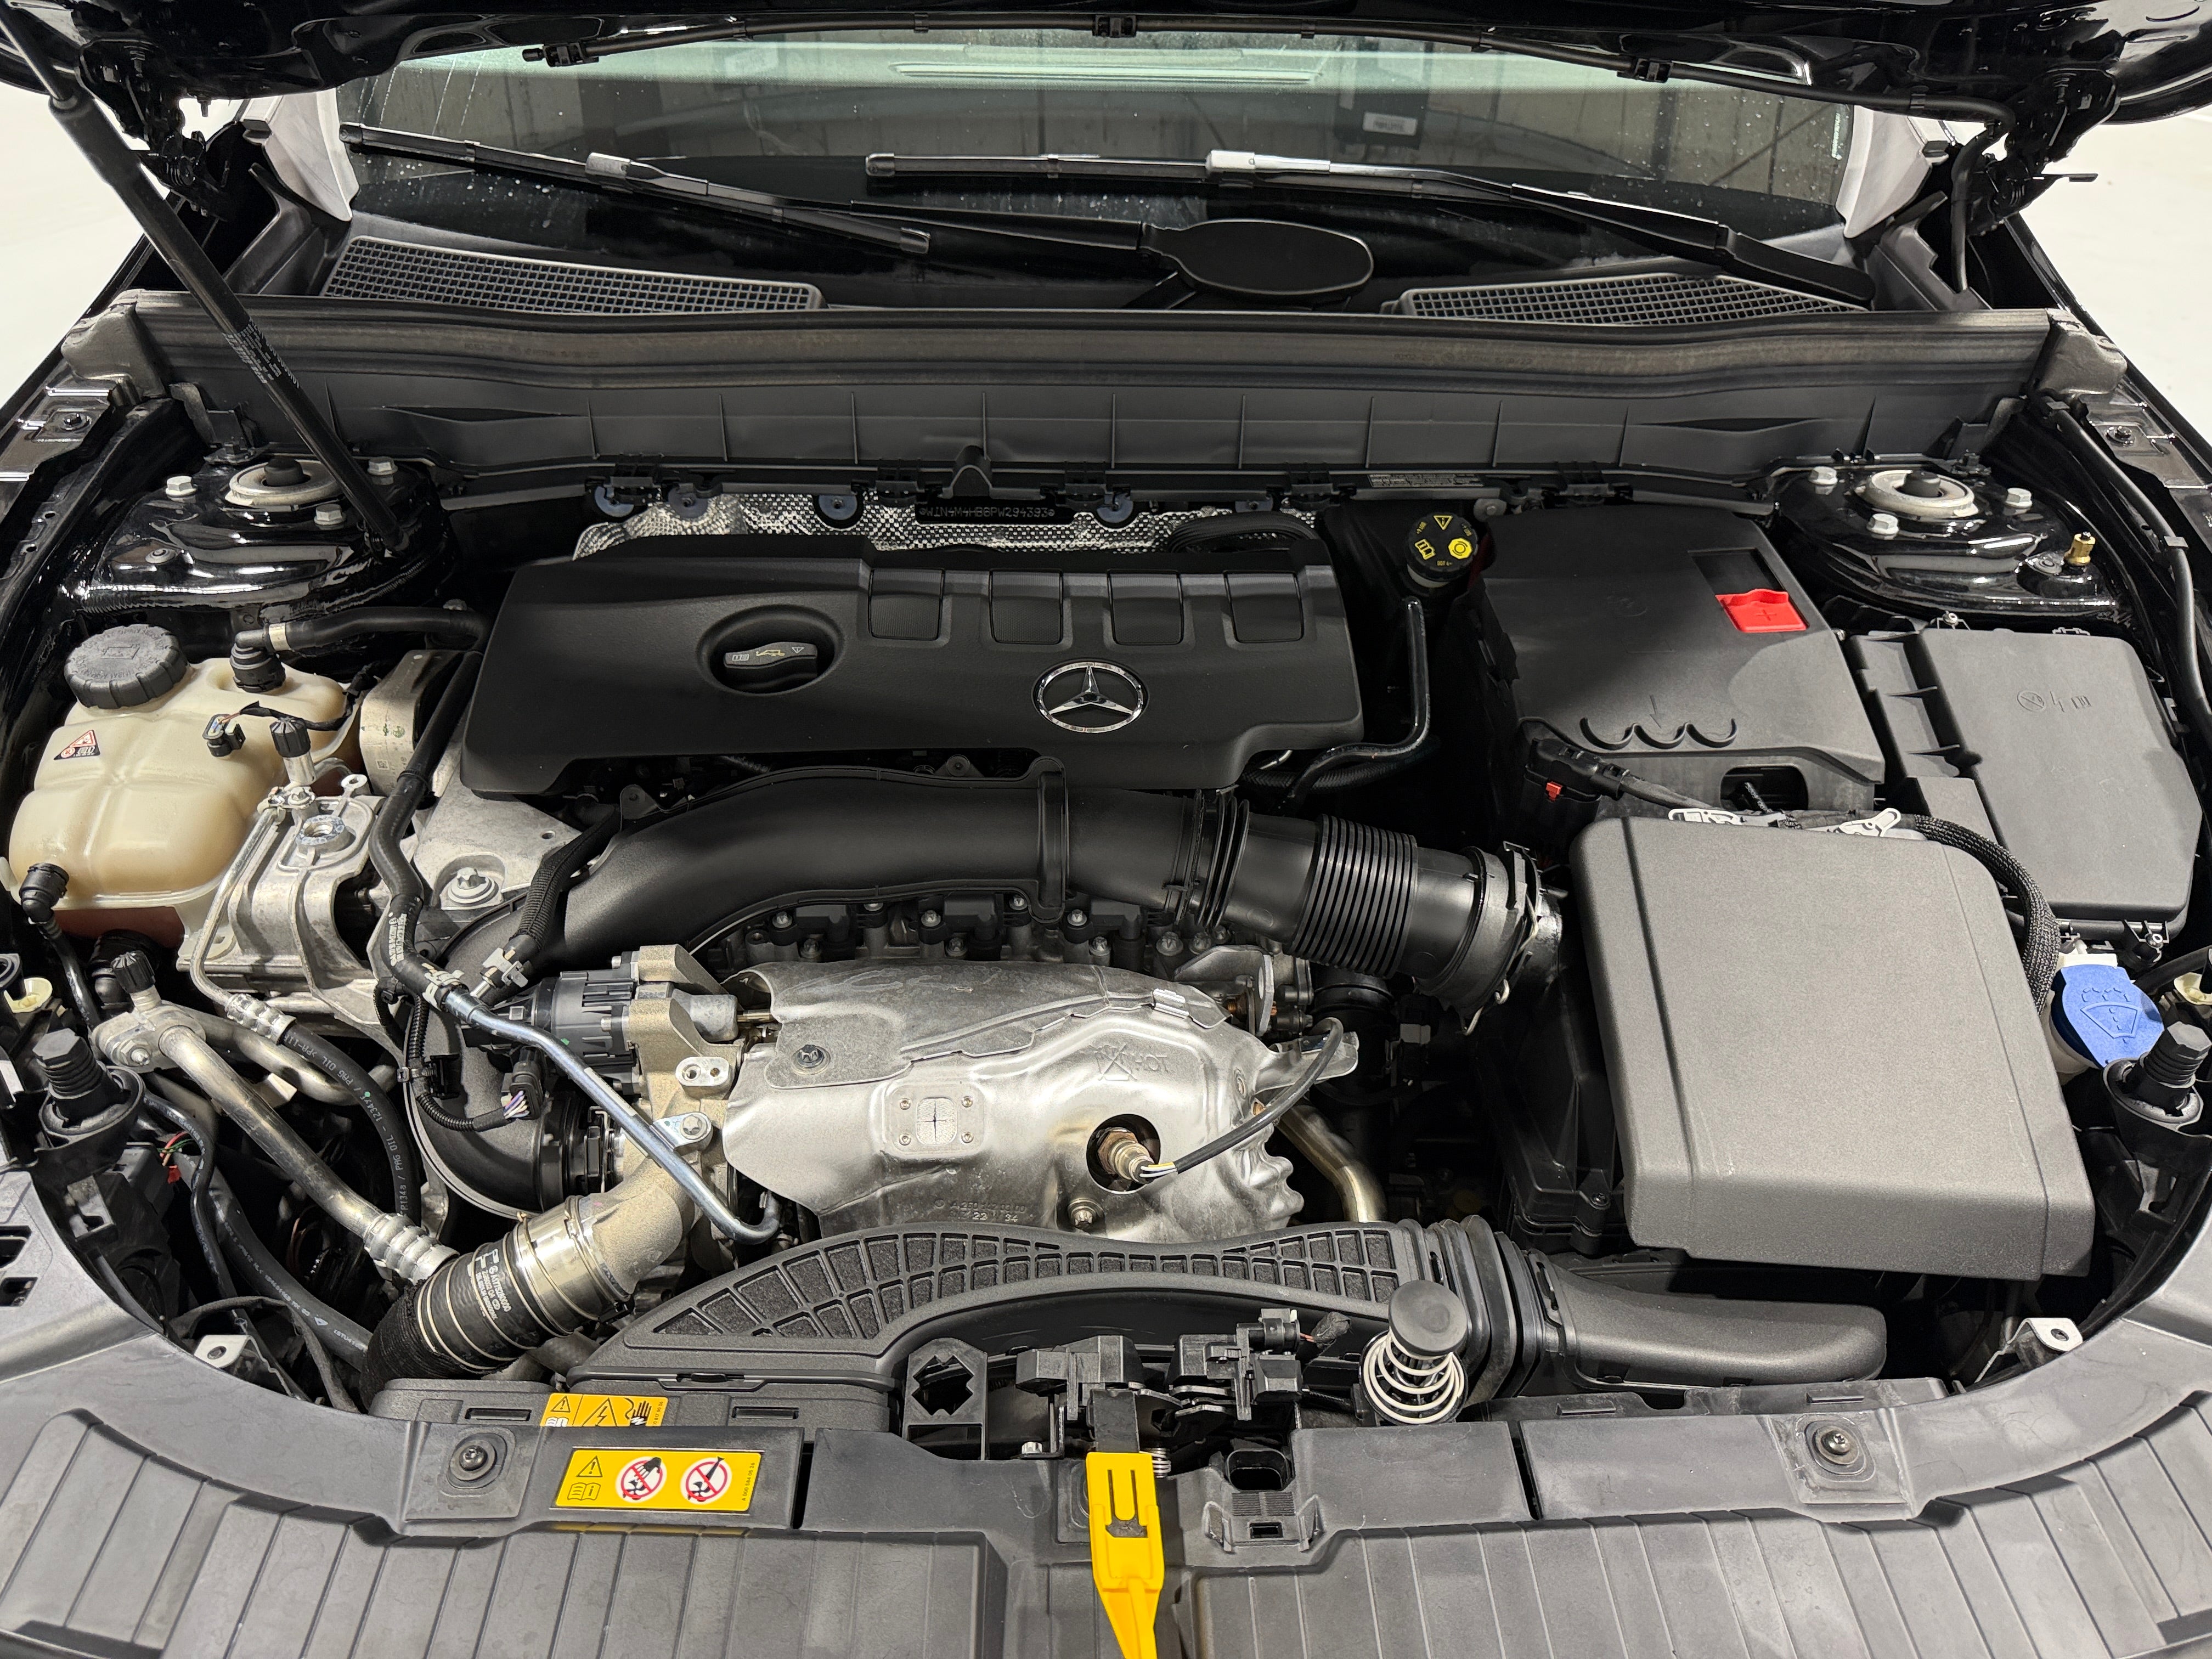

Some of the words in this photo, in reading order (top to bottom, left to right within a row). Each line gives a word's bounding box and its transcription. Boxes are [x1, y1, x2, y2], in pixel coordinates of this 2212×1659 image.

[319, 1056, 336, 1071] OIL
[337, 1069, 354, 1086] PAG
[386, 1135, 398, 1152] OIL
[392, 1154, 404, 1171] PAG
[972, 1211, 988, 1221] 22
